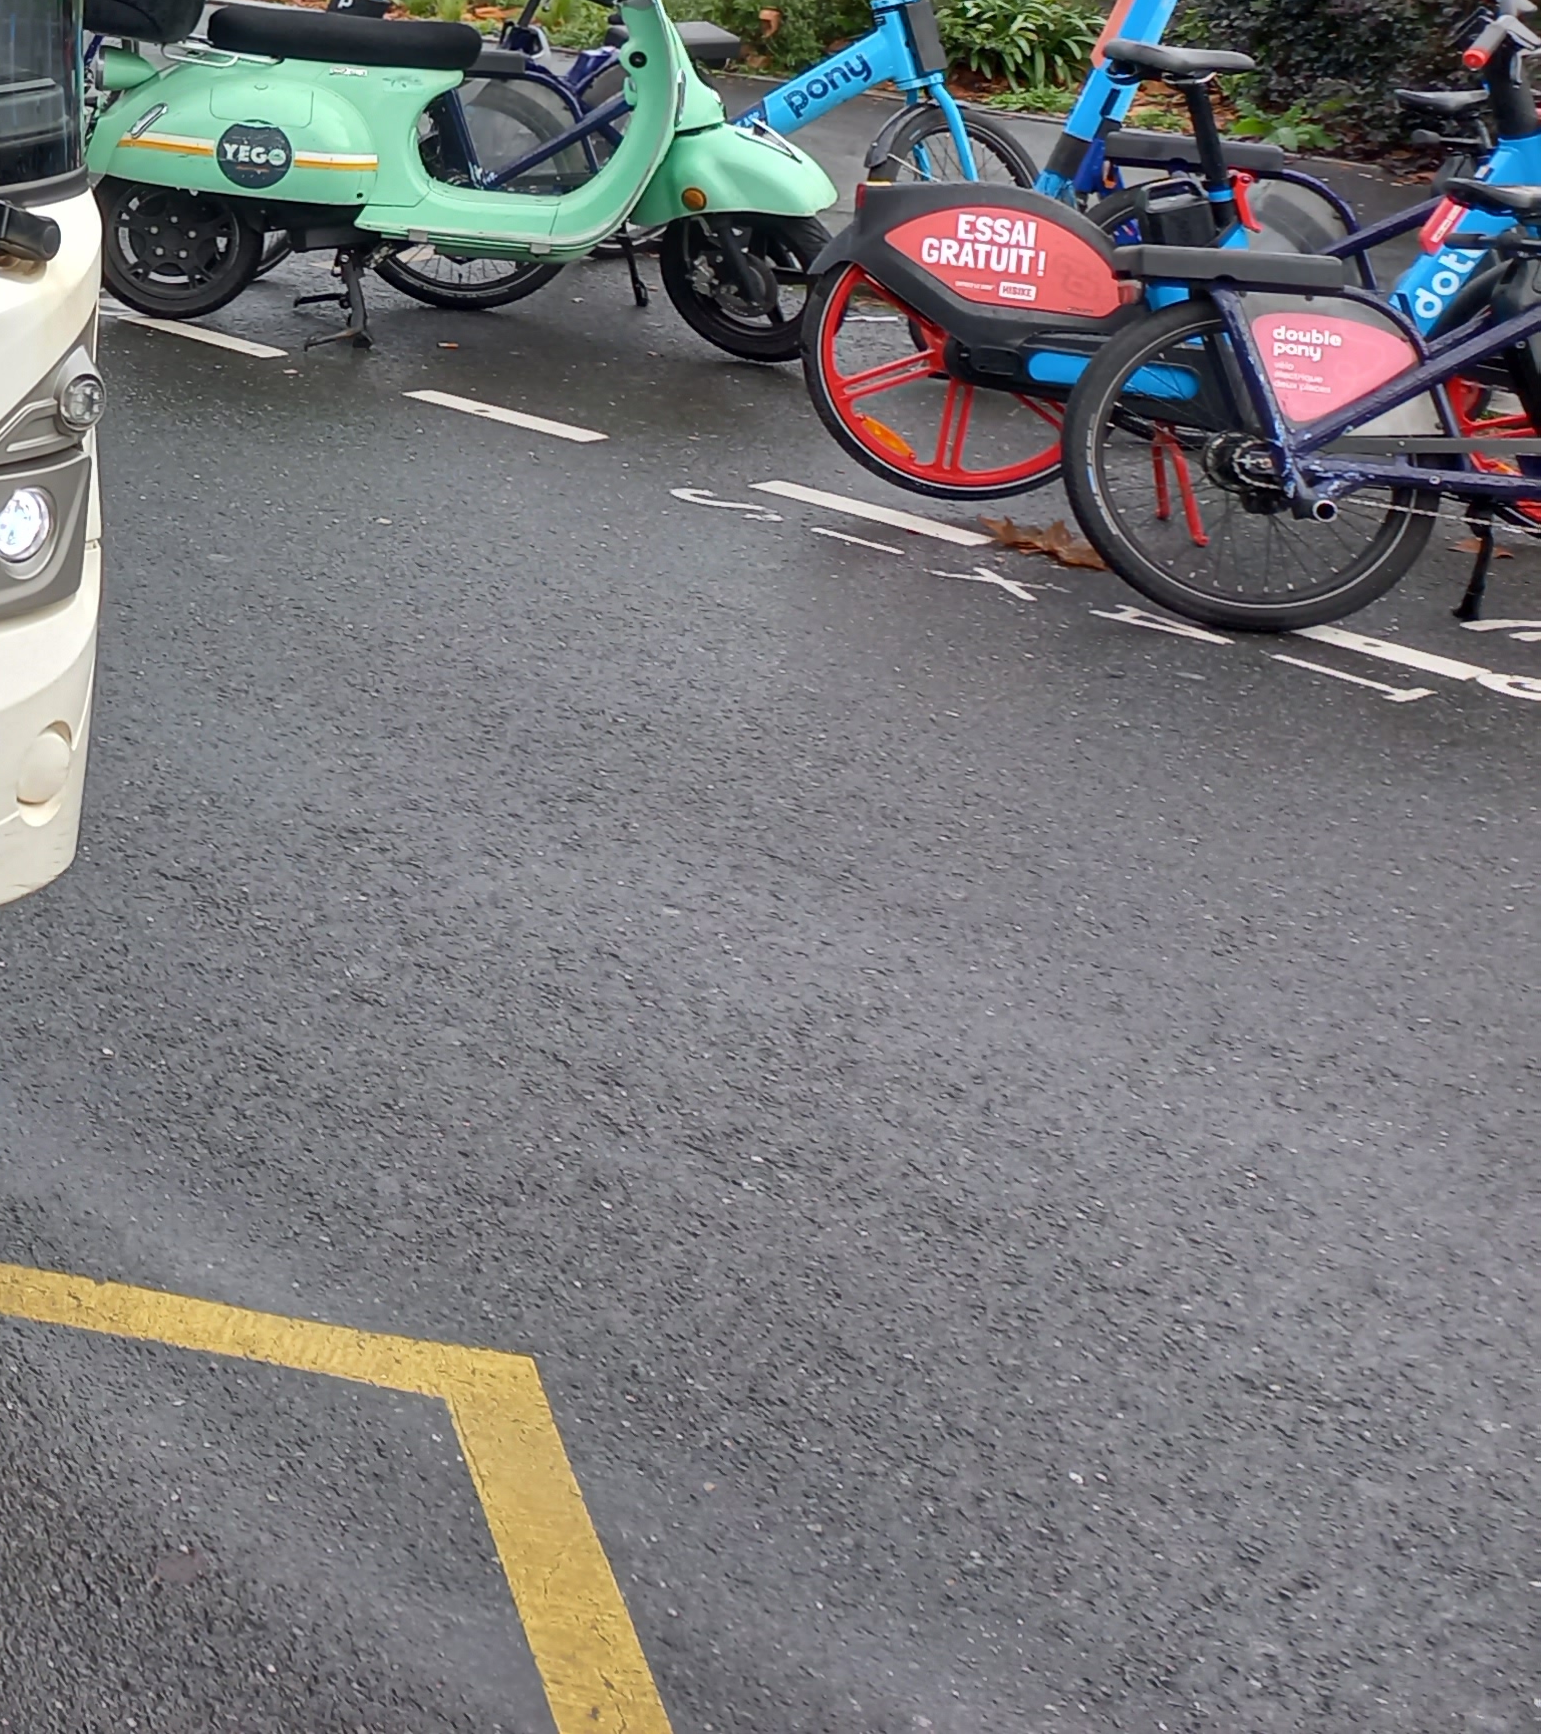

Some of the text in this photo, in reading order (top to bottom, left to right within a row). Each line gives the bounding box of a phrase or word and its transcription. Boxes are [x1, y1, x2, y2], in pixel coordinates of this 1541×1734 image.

[783, 52, 873, 120] pony
[222, 142, 287, 167] YEGO
[956, 213, 1038, 248] ESSAI
[1415, 248, 1486, 319] dot
[1272, 325, 1343, 347] double
[1272, 341, 1323, 362] pony
